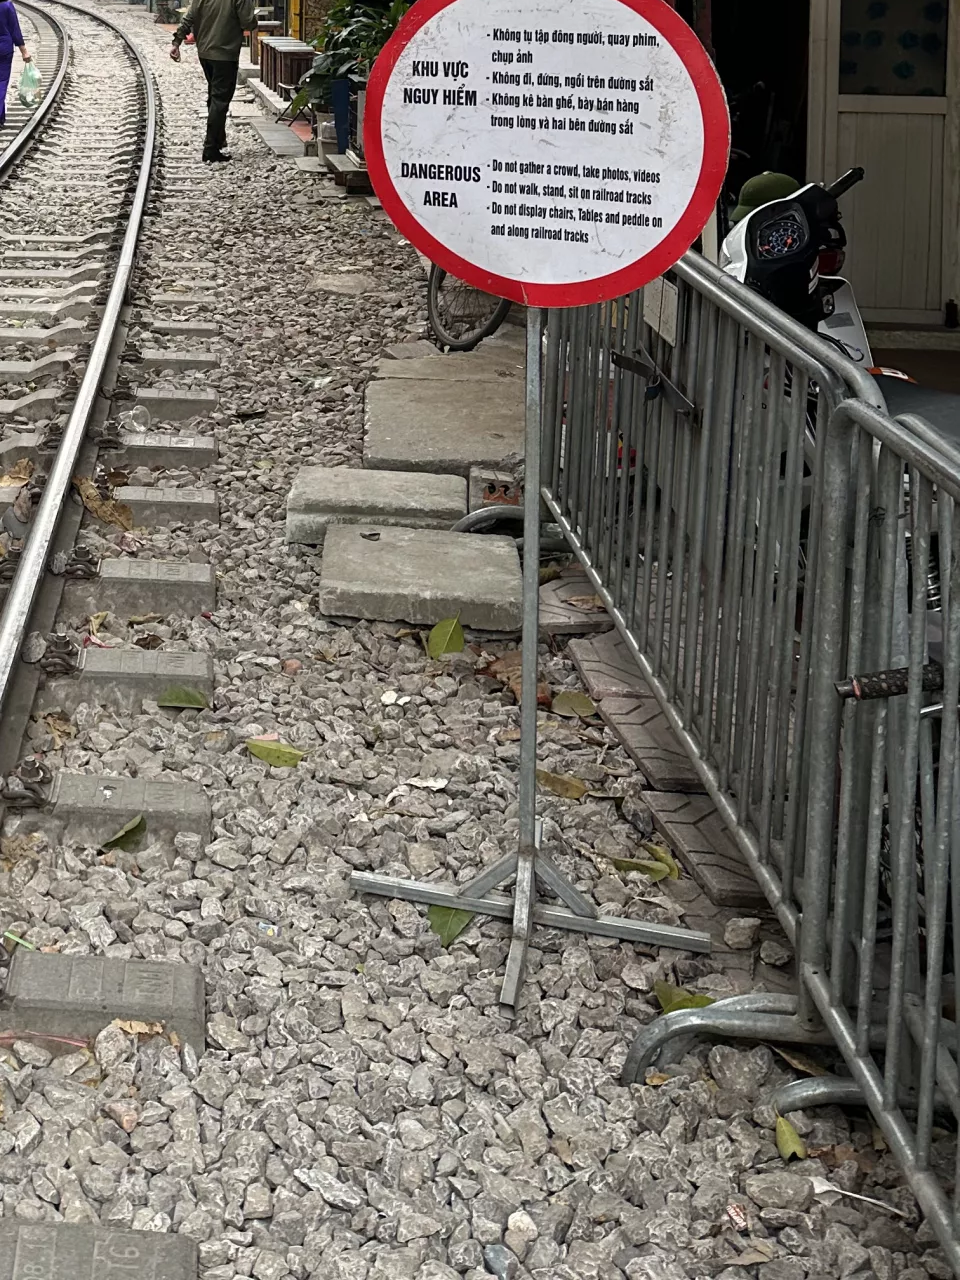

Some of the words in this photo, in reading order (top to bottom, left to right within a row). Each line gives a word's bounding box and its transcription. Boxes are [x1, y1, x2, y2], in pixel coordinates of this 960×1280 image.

[492, 27, 521, 43] Không
[523, 29, 532, 44] tụ
[534, 28, 549, 45] tập
[551, 29, 574, 45] đông
[576, 30, 605, 46] người,
[607, 33, 630, 47] quay
[632, 32, 659, 47] phim,
[491, 49, 513, 65] chụp
[515, 48, 532, 63] ảnh
[411, 60, 438, 77] KHU
[442, 59, 468, 81] VỰC
[492, 70, 520, 86] Không
[522, 72, 534, 86] đi,
[536, 72, 562, 88] đứng,
[586, 74, 605, 88] trên
[607, 76, 636, 92] đường
[638, 74, 653, 91] sắt
[403, 87, 439, 104] NGUY
[442, 83, 477, 106] HIỂM
[491, 92, 520, 108] Không
[522, 93, 533, 107] kê
[536, 94, 553, 107] bàn
[555, 93, 575, 110] ghế,
[577, 96, 594, 111] bày
[596, 97, 613, 111] bán
[616, 98, 639, 114] hàng
[490, 114, 514, 129] trong
[516, 114, 536, 130] lòng
[538, 116, 549, 129] và
[551, 116, 566, 130] hai
[568, 117, 585, 131] bên
[588, 118, 616, 135] đường
[618, 118, 633, 134] sắt
[400, 161, 480, 182] DANGEROUS
[492, 158, 502, 172] Do
[504, 160, 517, 172] not
[519, 161, 544, 174] gather
[546, 164, 551, 175] a
[553, 163, 580, 178] crowd,
[582, 164, 600, 178] take
[601, 166, 631, 182] photos,
[633, 168, 660, 183] videos
[422, 190, 458, 208] AREA
[491, 180, 502, 193] Do
[504, 181, 517, 194] not
[518, 182, 540, 196] walk,
[542, 184, 566, 198] stand,
[568, 185, 578, 198] sit
[580, 188, 590, 199] on
[592, 188, 623, 202] railroad
[625, 190, 651, 205] tracks
[491, 201, 502, 214] Do
[503, 203, 516, 215] not
[518, 203, 547, 219] display
[548, 205, 575, 221] chairs,
[577, 207, 603, 222] Tables
[604, 211, 620, 224] and
[621, 212, 649, 227] peddle
[651, 216, 662, 227] on
[490, 223, 505, 236] and
[507, 224, 529, 239] along
[530, 226, 562, 240] railroad
[563, 228, 588, 243] tracks
